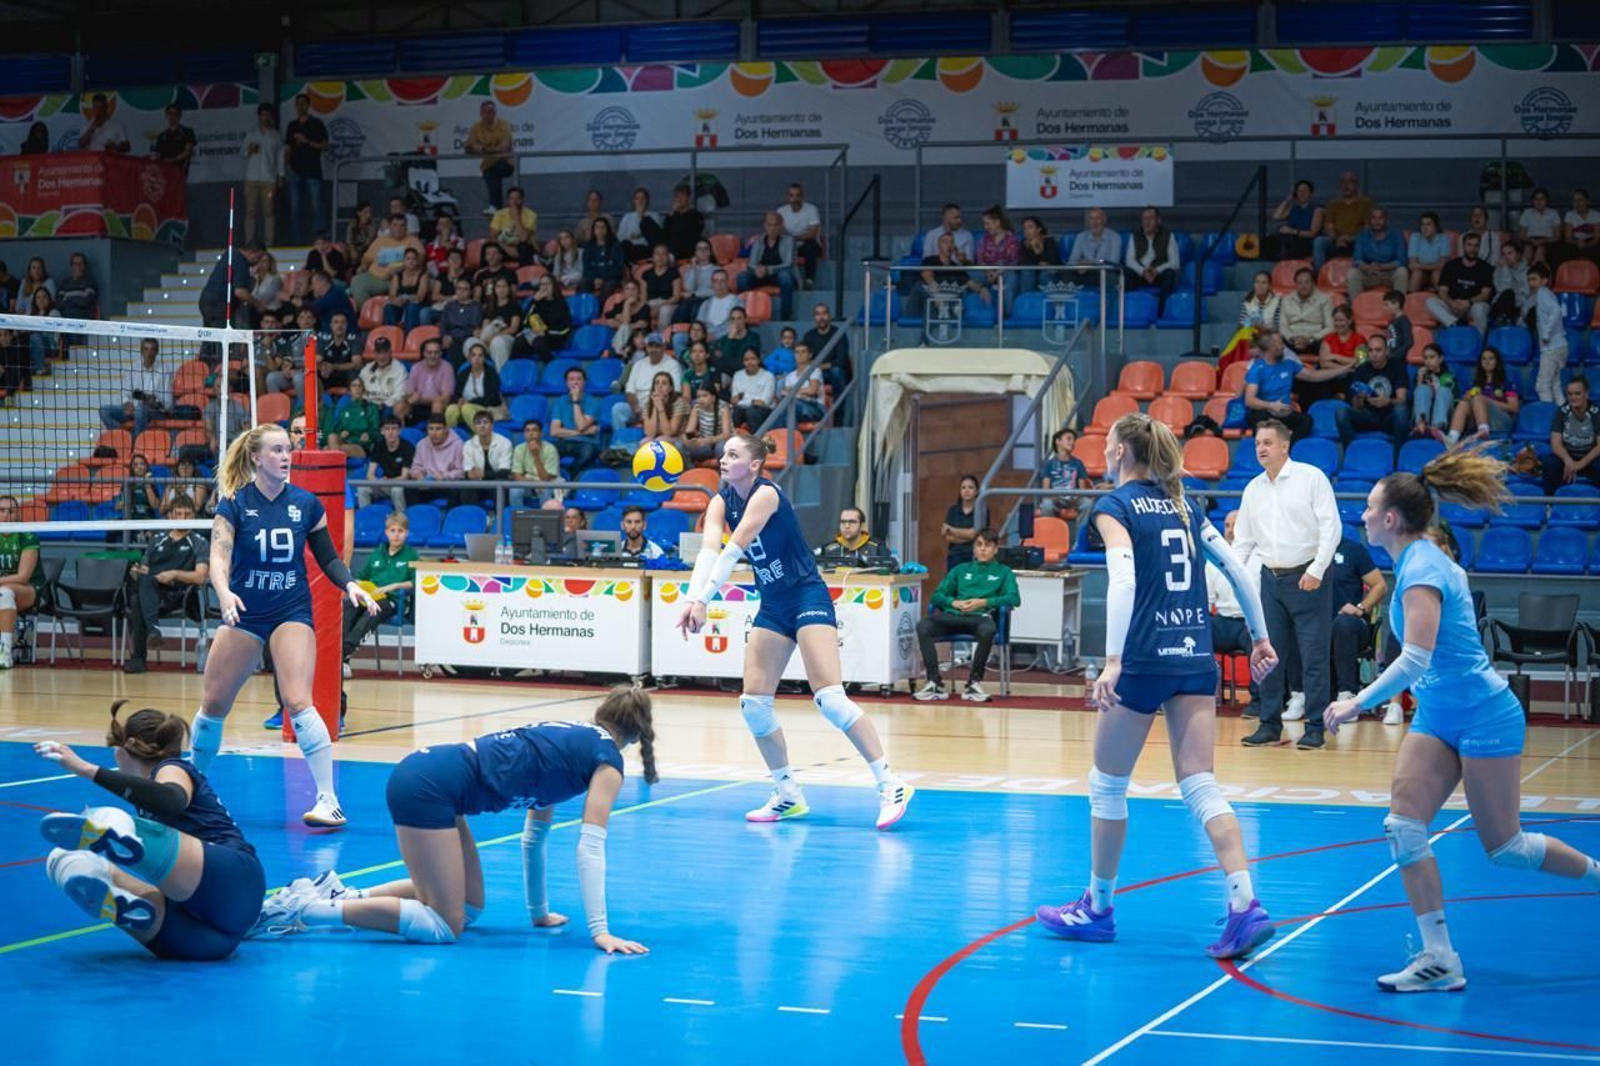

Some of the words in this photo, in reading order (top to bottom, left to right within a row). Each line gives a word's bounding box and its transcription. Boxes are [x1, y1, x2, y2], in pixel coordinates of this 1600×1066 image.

[1036, 107, 1111, 119] Ayuntamiento
[1112, 107, 1129, 118] de
[1355, 101, 1432, 113] Ayuntamiento
[1436, 101, 1451, 112] de
[734, 112, 805, 125] Ayuntamiento
[808, 112, 822, 123] de
[1355, 116, 1381, 129] Dos
[1385, 116, 1451, 129] Hermanas
[734, 127, 758, 140] Dos
[761, 126, 822, 139] Hermanas
[1036, 122, 1061, 134] Dos
[1064, 121, 1129, 133] Hermanas
[1070, 168, 1130, 179] Ayuntamiento
[1133, 168, 1144, 177] de
[38, 179, 56, 190] Dos
[1069, 180, 1089, 191] Dos
[1092, 180, 1144, 190] Hermanas
[254, 527, 295, 563] 19
[1161, 528, 1192, 592] 3
[244, 569, 297, 591] JTRE
[500, 606, 577, 621] Ayuntamiento
[579, 608, 595, 621] de
[500, 622, 527, 636] Dos
[529, 623, 595, 638] Hermanas
[499, 637, 531, 647] Deportes
